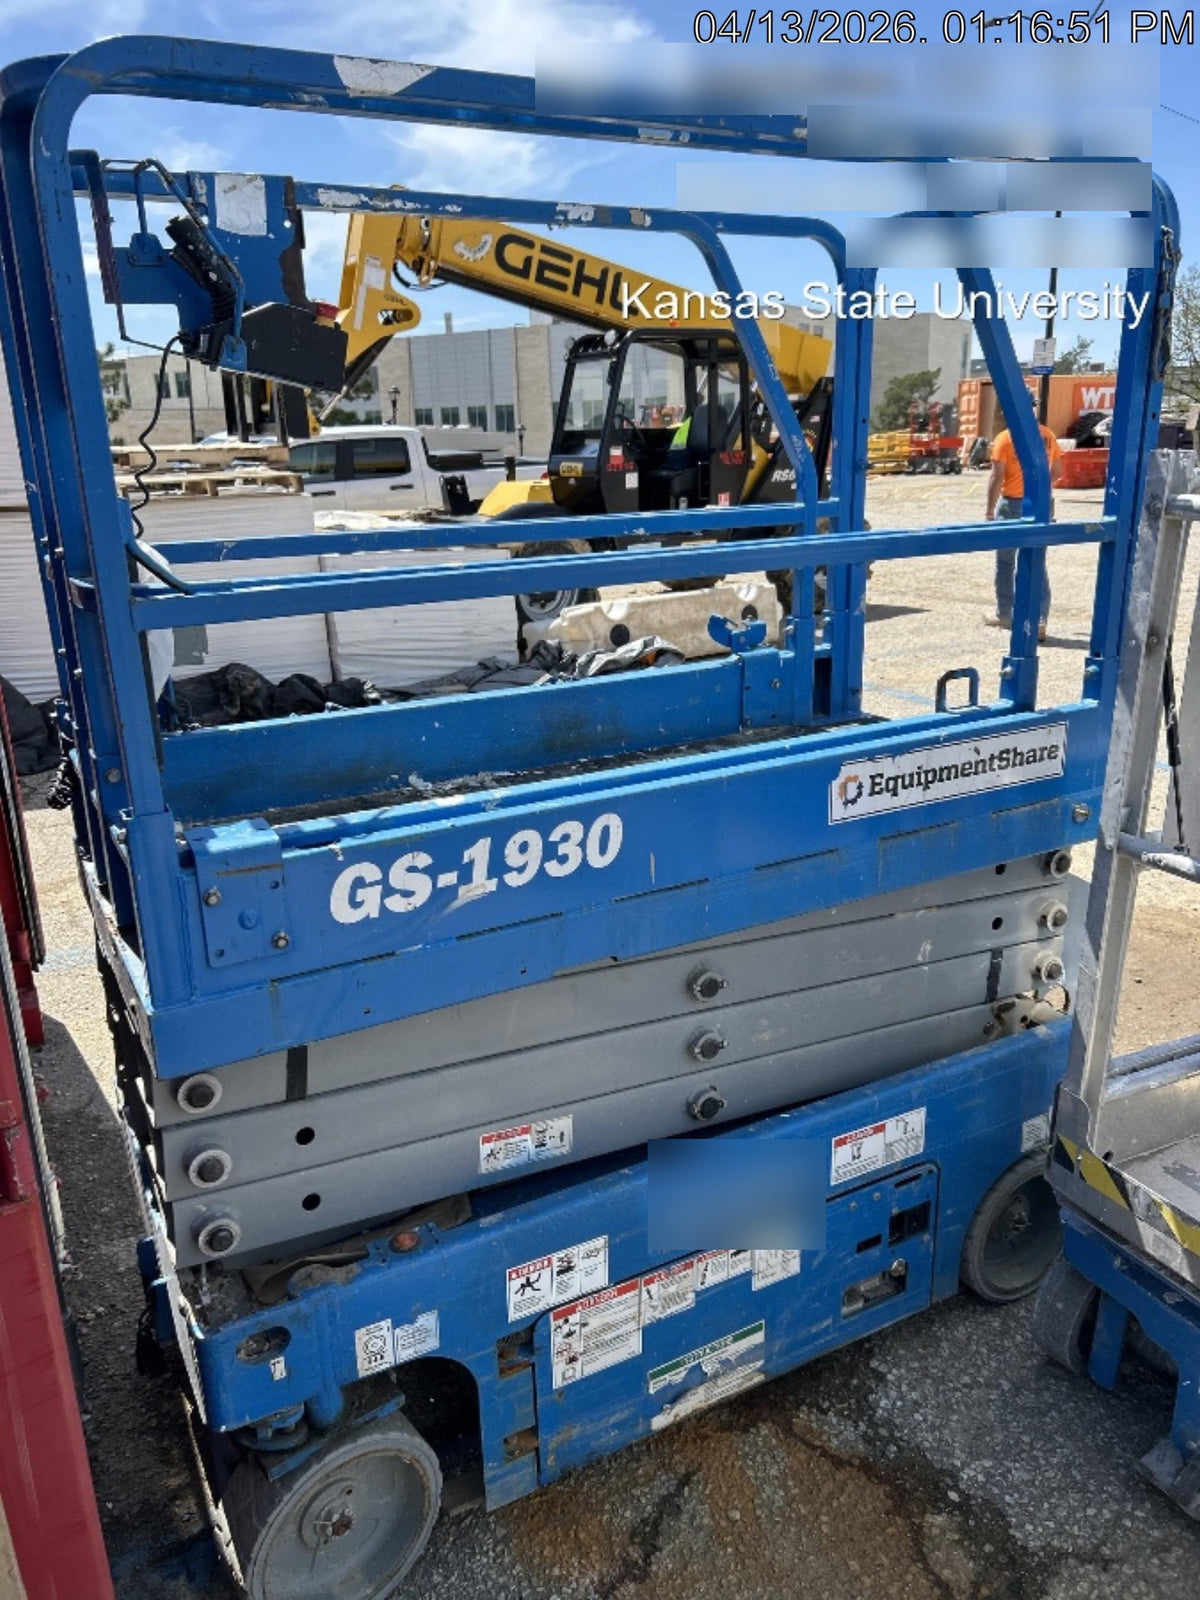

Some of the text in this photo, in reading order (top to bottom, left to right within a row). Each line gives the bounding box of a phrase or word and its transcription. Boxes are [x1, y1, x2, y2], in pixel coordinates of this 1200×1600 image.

[494, 233, 639, 316] GEHL
[868, 743, 1059, 798] EquipmentShare
[329, 812, 623, 925] GS-1930
